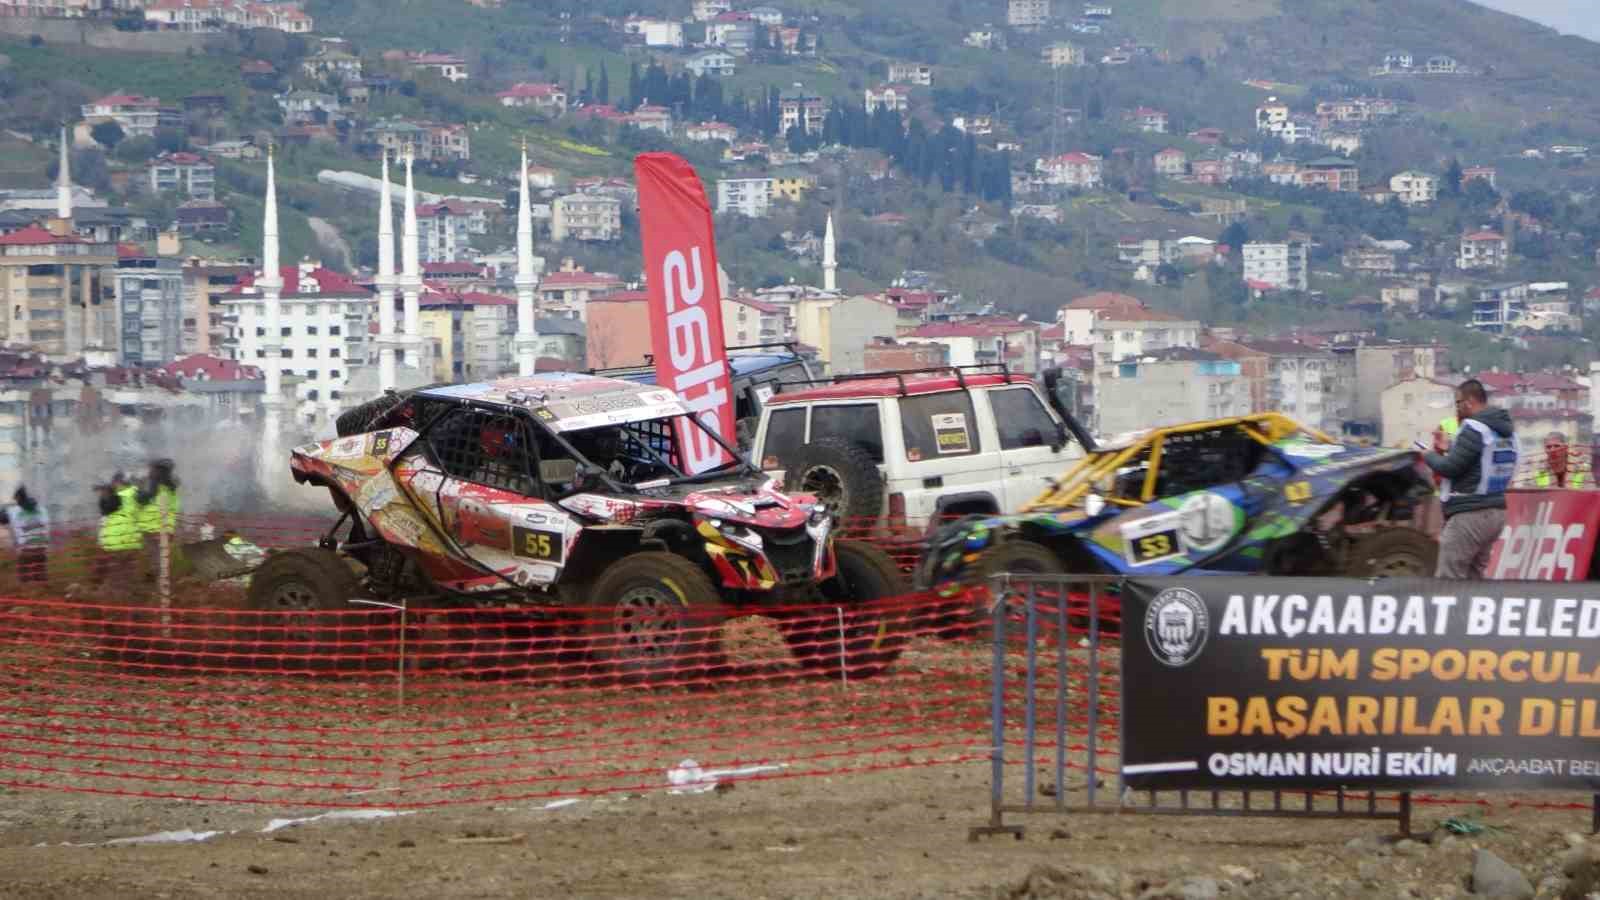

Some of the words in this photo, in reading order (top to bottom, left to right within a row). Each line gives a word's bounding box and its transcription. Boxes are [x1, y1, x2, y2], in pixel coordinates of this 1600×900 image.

[376, 438, 387, 450] 55
[525, 533, 551, 557] 55
[1140, 534, 1171, 557] 53
[1219, 595, 1457, 638] AKÇAABAT
[1466, 596, 1600, 637] BELED
[1261, 648, 1359, 680] TÜM
[1207, 695, 1504, 739] BAŞARILAR
[1207, 752, 1305, 776] OSMAN
[1310, 747, 1380, 776] NURİ
[1386, 746, 1458, 776] EKİM
[1467, 758, 1566, 776] AKÇAABAT
